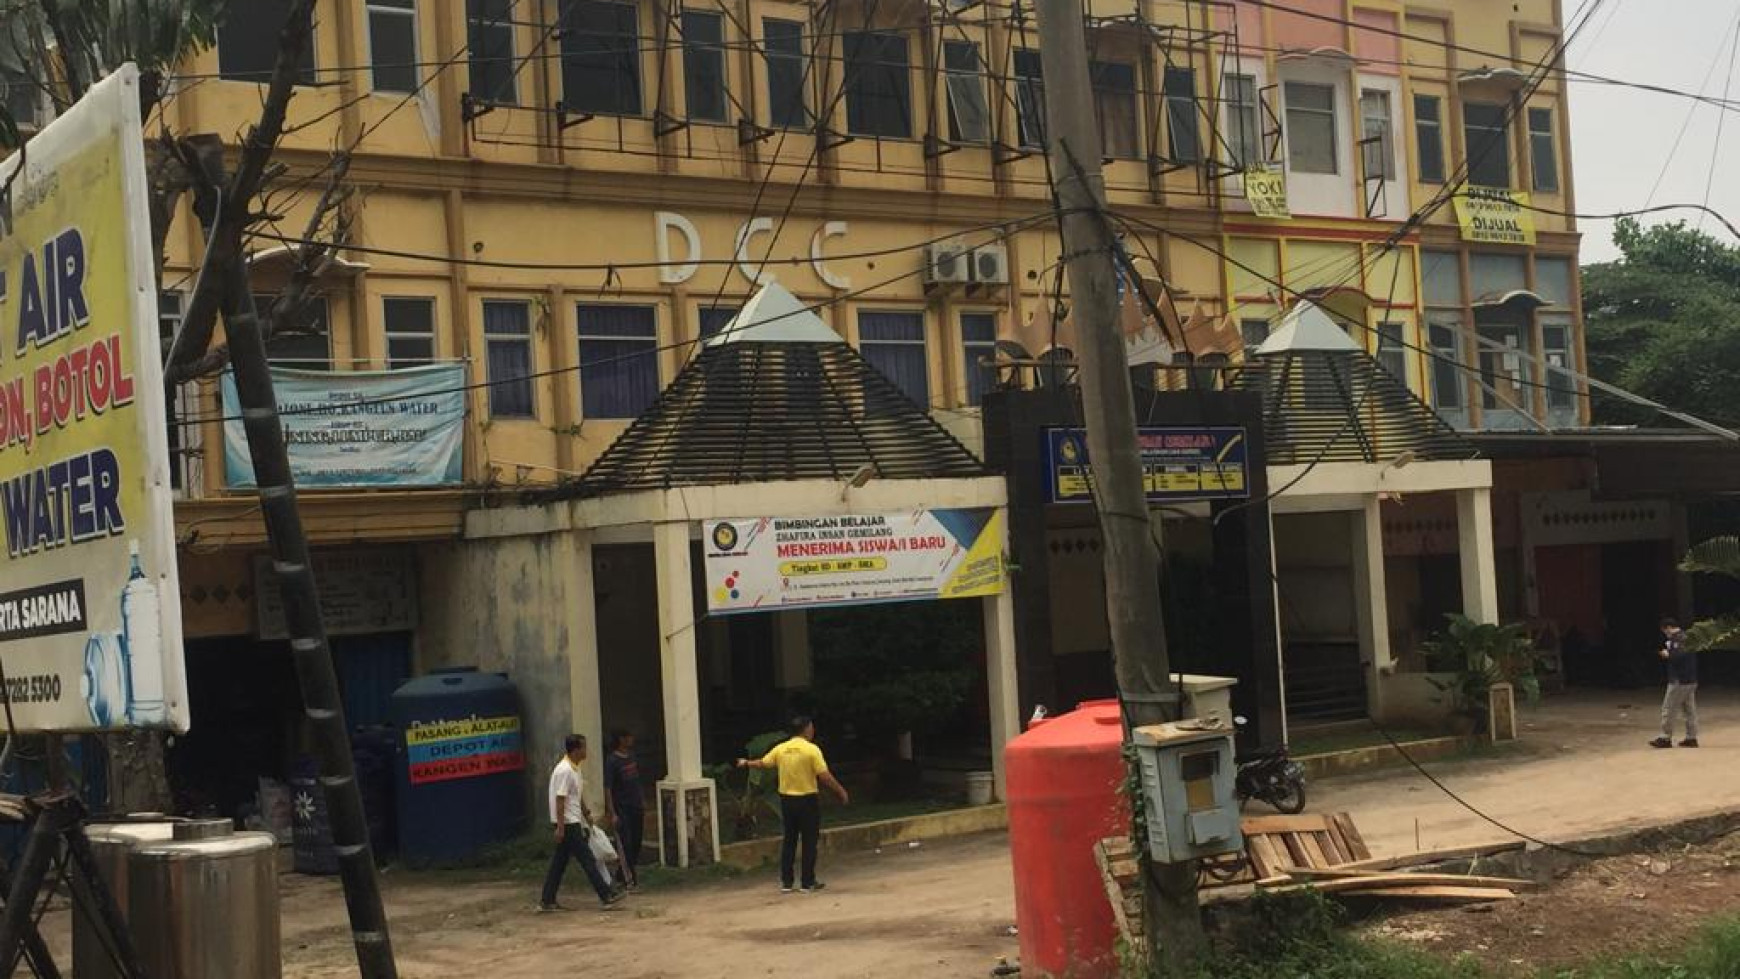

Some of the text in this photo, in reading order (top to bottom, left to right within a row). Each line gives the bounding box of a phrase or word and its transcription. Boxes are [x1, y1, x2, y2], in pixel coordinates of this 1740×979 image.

[1473, 217, 1522, 231] DIJUAL
[16, 227, 90, 357] AIR
[34, 333, 134, 436] BOTOL
[399, 402, 437, 414] WATER
[3, 449, 124, 557] WATER
[775, 515, 885, 531] BIMBINGAN BELAJAR
[777, 536, 946, 558] MENERIMA SISWA/I BARU
[21, 589, 81, 628] SARANA
[31, 673, 60, 703] 5300
[414, 724, 462, 741] PASANG
[431, 740, 485, 757] DEPOT
[412, 760, 481, 778] KANGEN
